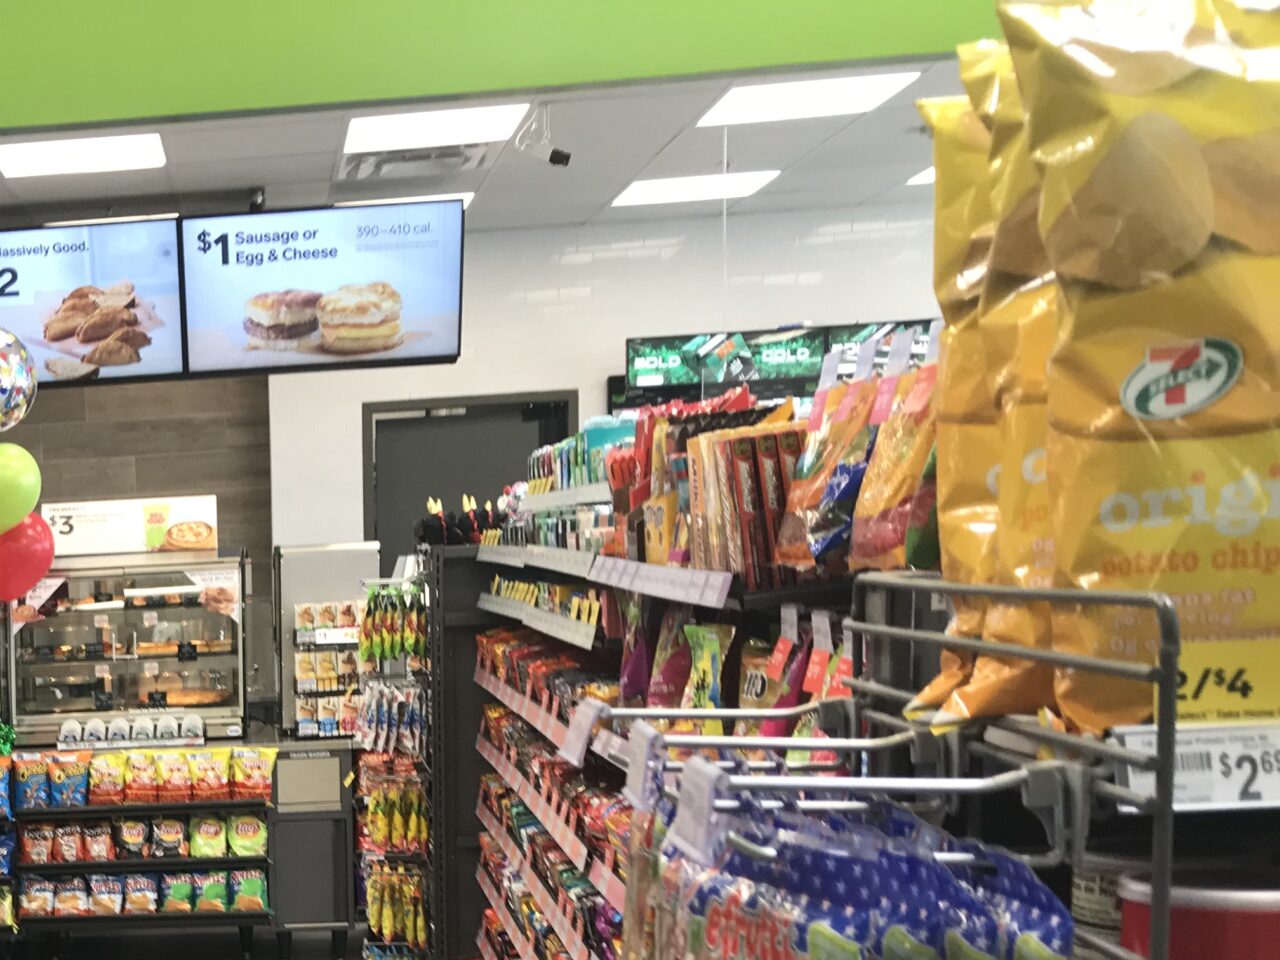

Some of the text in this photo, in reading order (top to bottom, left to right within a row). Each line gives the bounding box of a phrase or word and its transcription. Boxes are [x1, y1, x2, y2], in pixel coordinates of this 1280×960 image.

[235, 229, 319, 246] Sausage or
[53, 241, 89, 253] Good.
[197, 229, 229, 265] $1
[236, 248, 338, 266] Egg & Cheese
